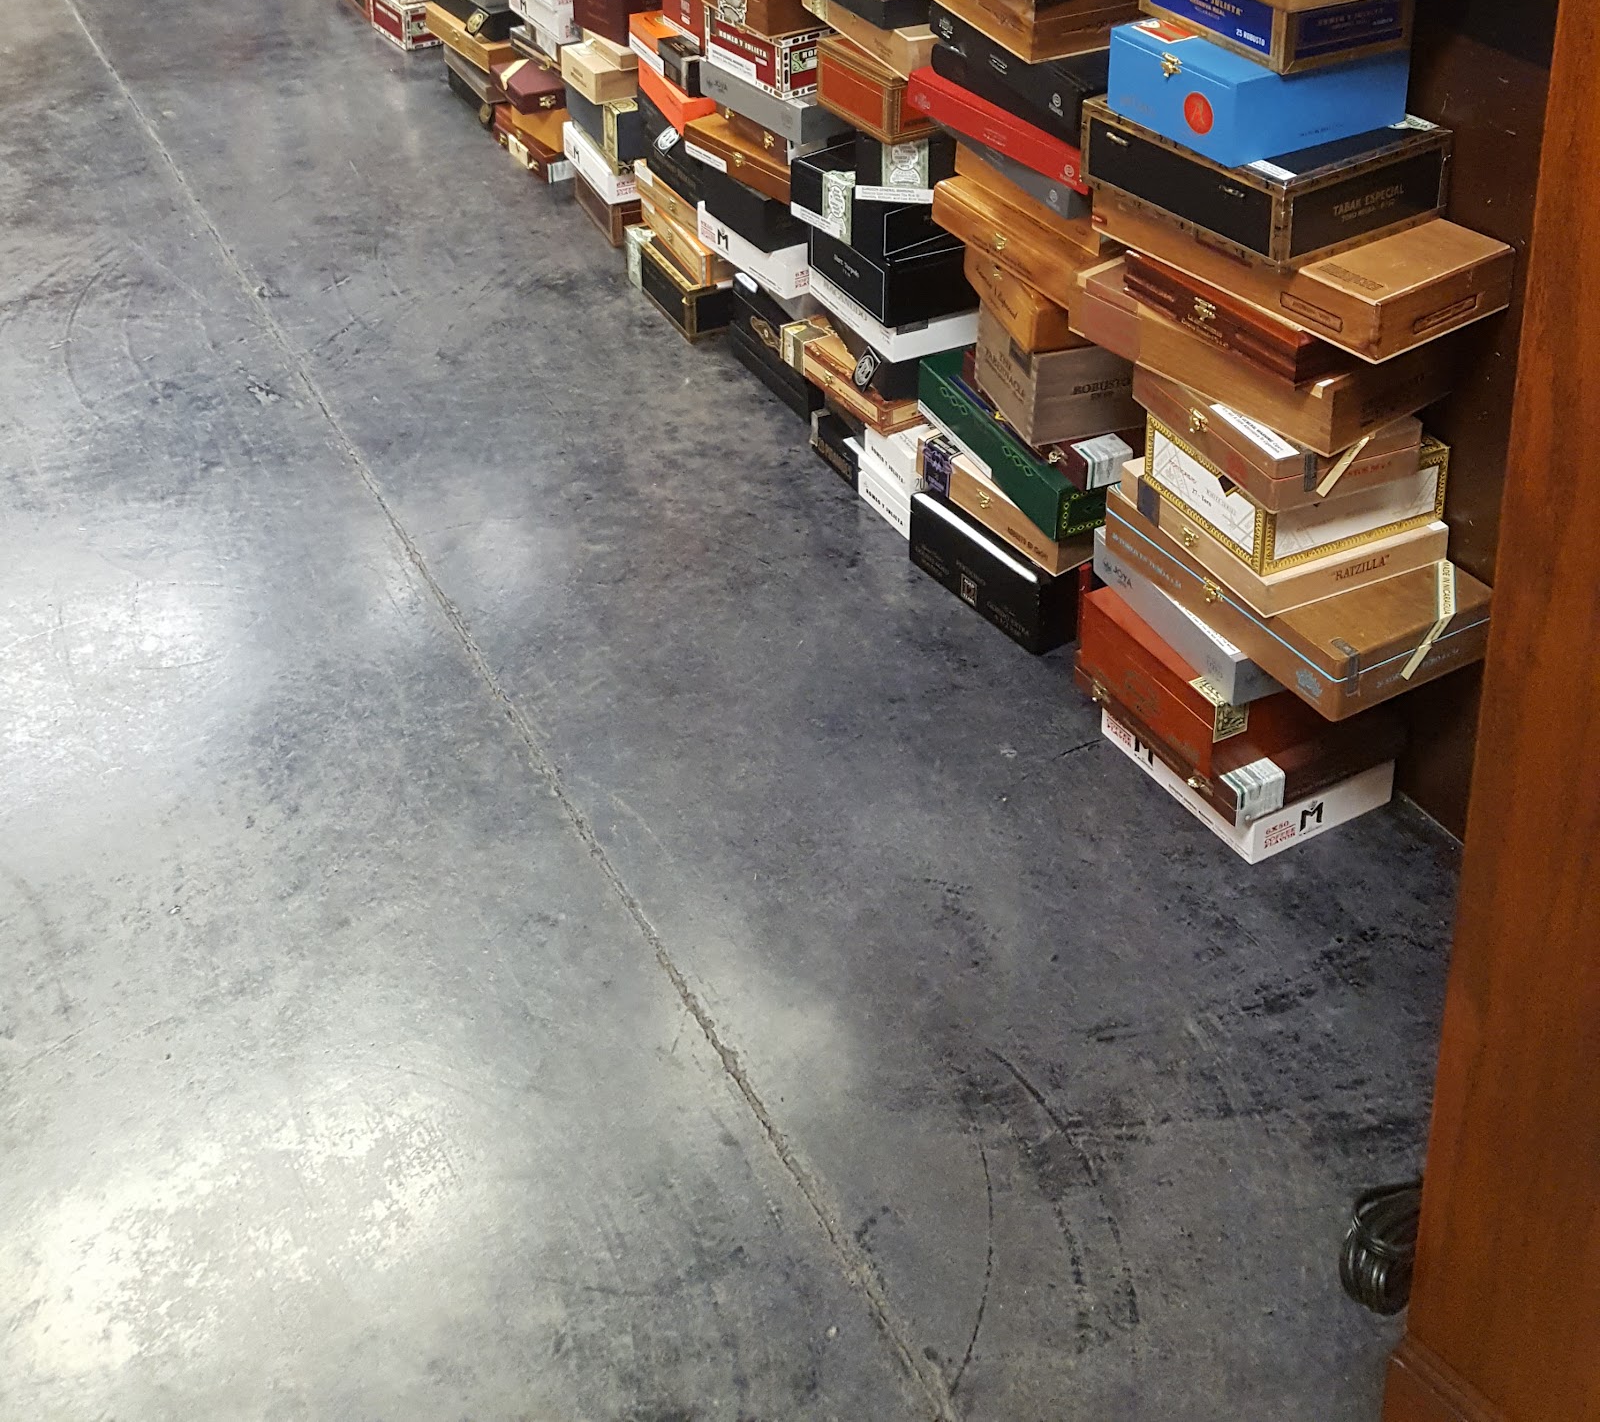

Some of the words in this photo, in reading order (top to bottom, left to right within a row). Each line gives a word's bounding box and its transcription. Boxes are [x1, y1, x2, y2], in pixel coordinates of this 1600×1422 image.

[718, 30, 739, 45] ROMEO
[744, 40, 768, 58] JULIETA
[1235, 28, 1243, 37] 25
[1243, 31, 1265, 47] ROBUSTO
[1332, 198, 1363, 217] TABAK
[1364, 184, 1405, 207] ESPECIAL
[1072, 378, 1132, 395] ROBUSTO
[1112, 565, 1133, 589] JOYA
[1443, 562, 1452, 577] MADE
[1442, 583, 1452, 615] NICARAGUA
[1300, 801, 1324, 833] M
[1264, 828, 1297, 844] COFFEE
[1264, 834, 1297, 849] FLAVOR
